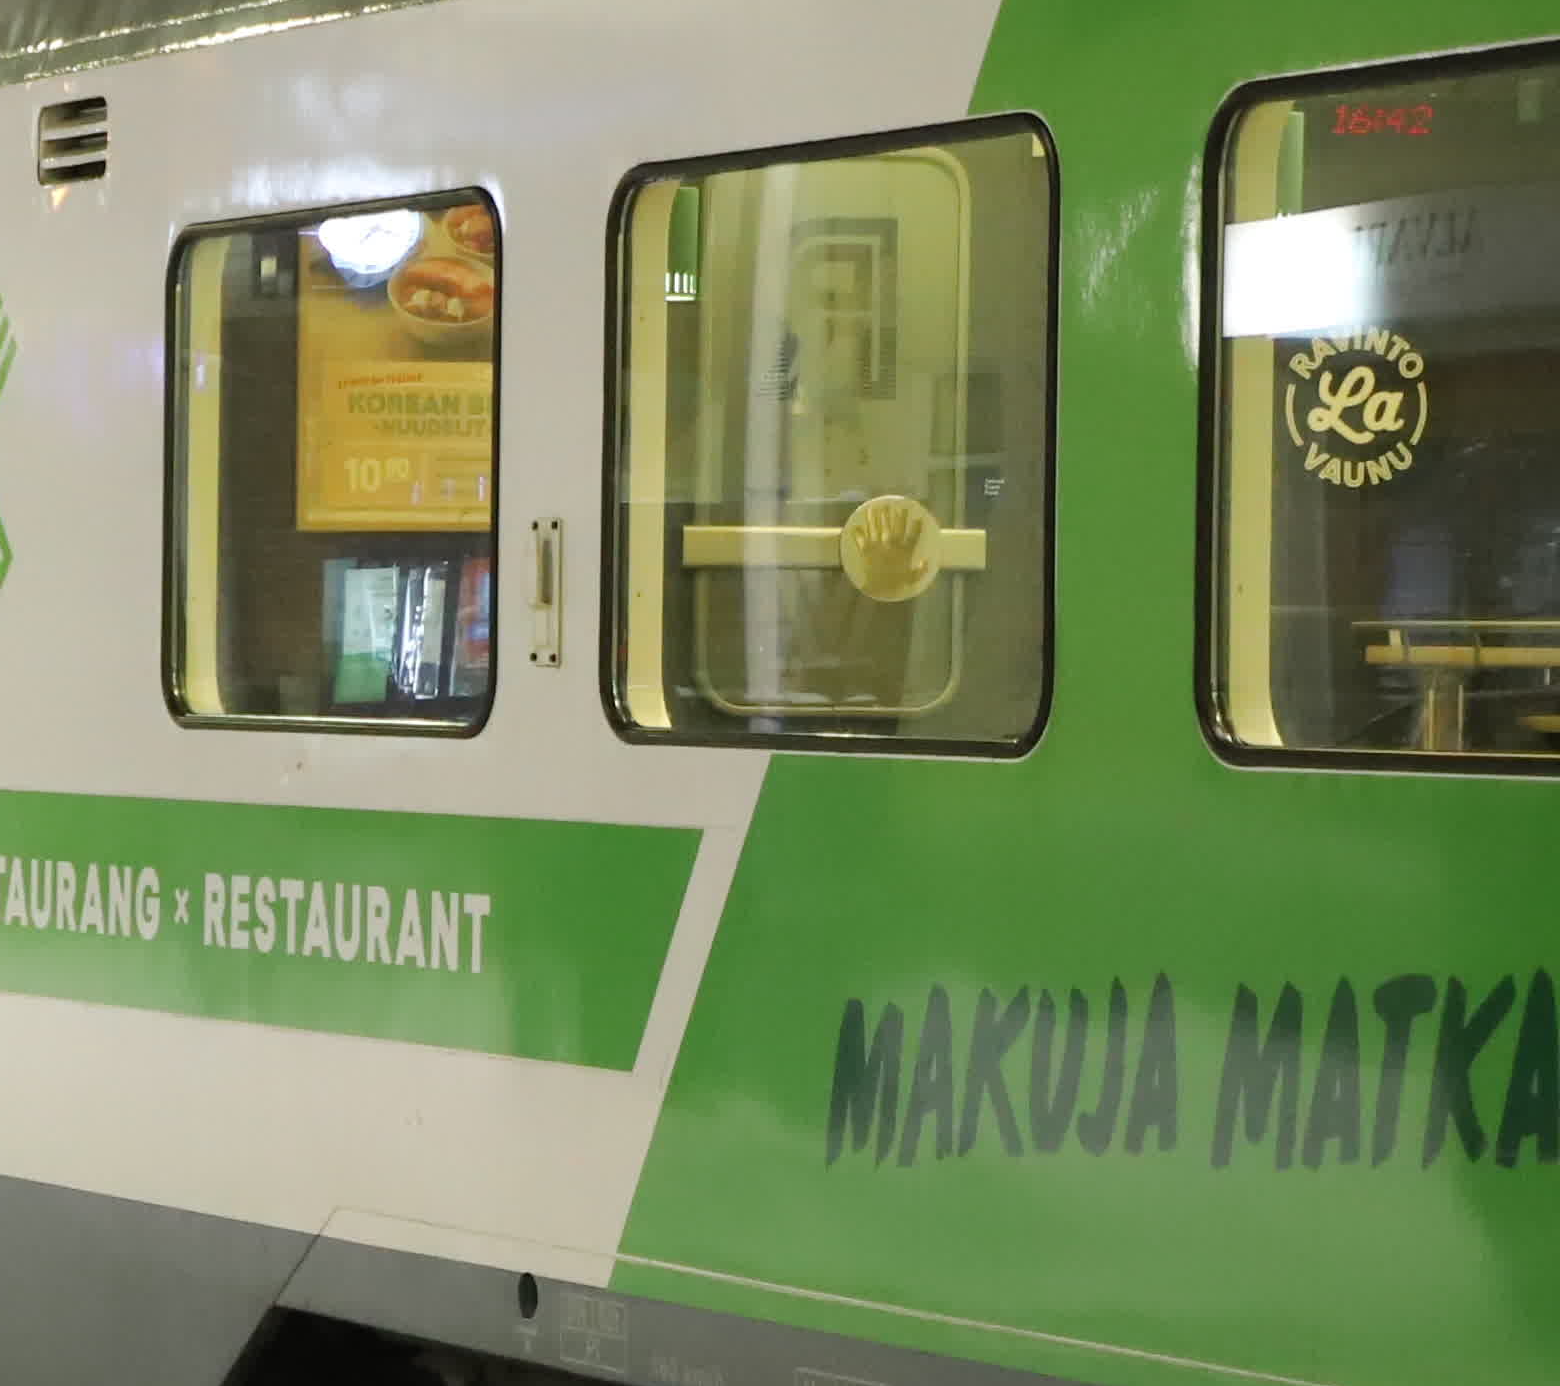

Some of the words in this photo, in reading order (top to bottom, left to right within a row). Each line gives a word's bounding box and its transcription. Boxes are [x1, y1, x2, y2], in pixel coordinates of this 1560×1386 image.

[1332, 104, 1435, 136] 16:42
[1289, 325, 1424, 380] RAVINTO
[348, 391, 459, 415] KOREAN
[1307, 365, 1405, 445] La
[1303, 441, 1413, 488] VAUNU
[203, 871, 492, 974] RESTAURANT
[825, 969, 1178, 1173] MAKUJA
[1210, 965, 1560, 1173] MATKA
